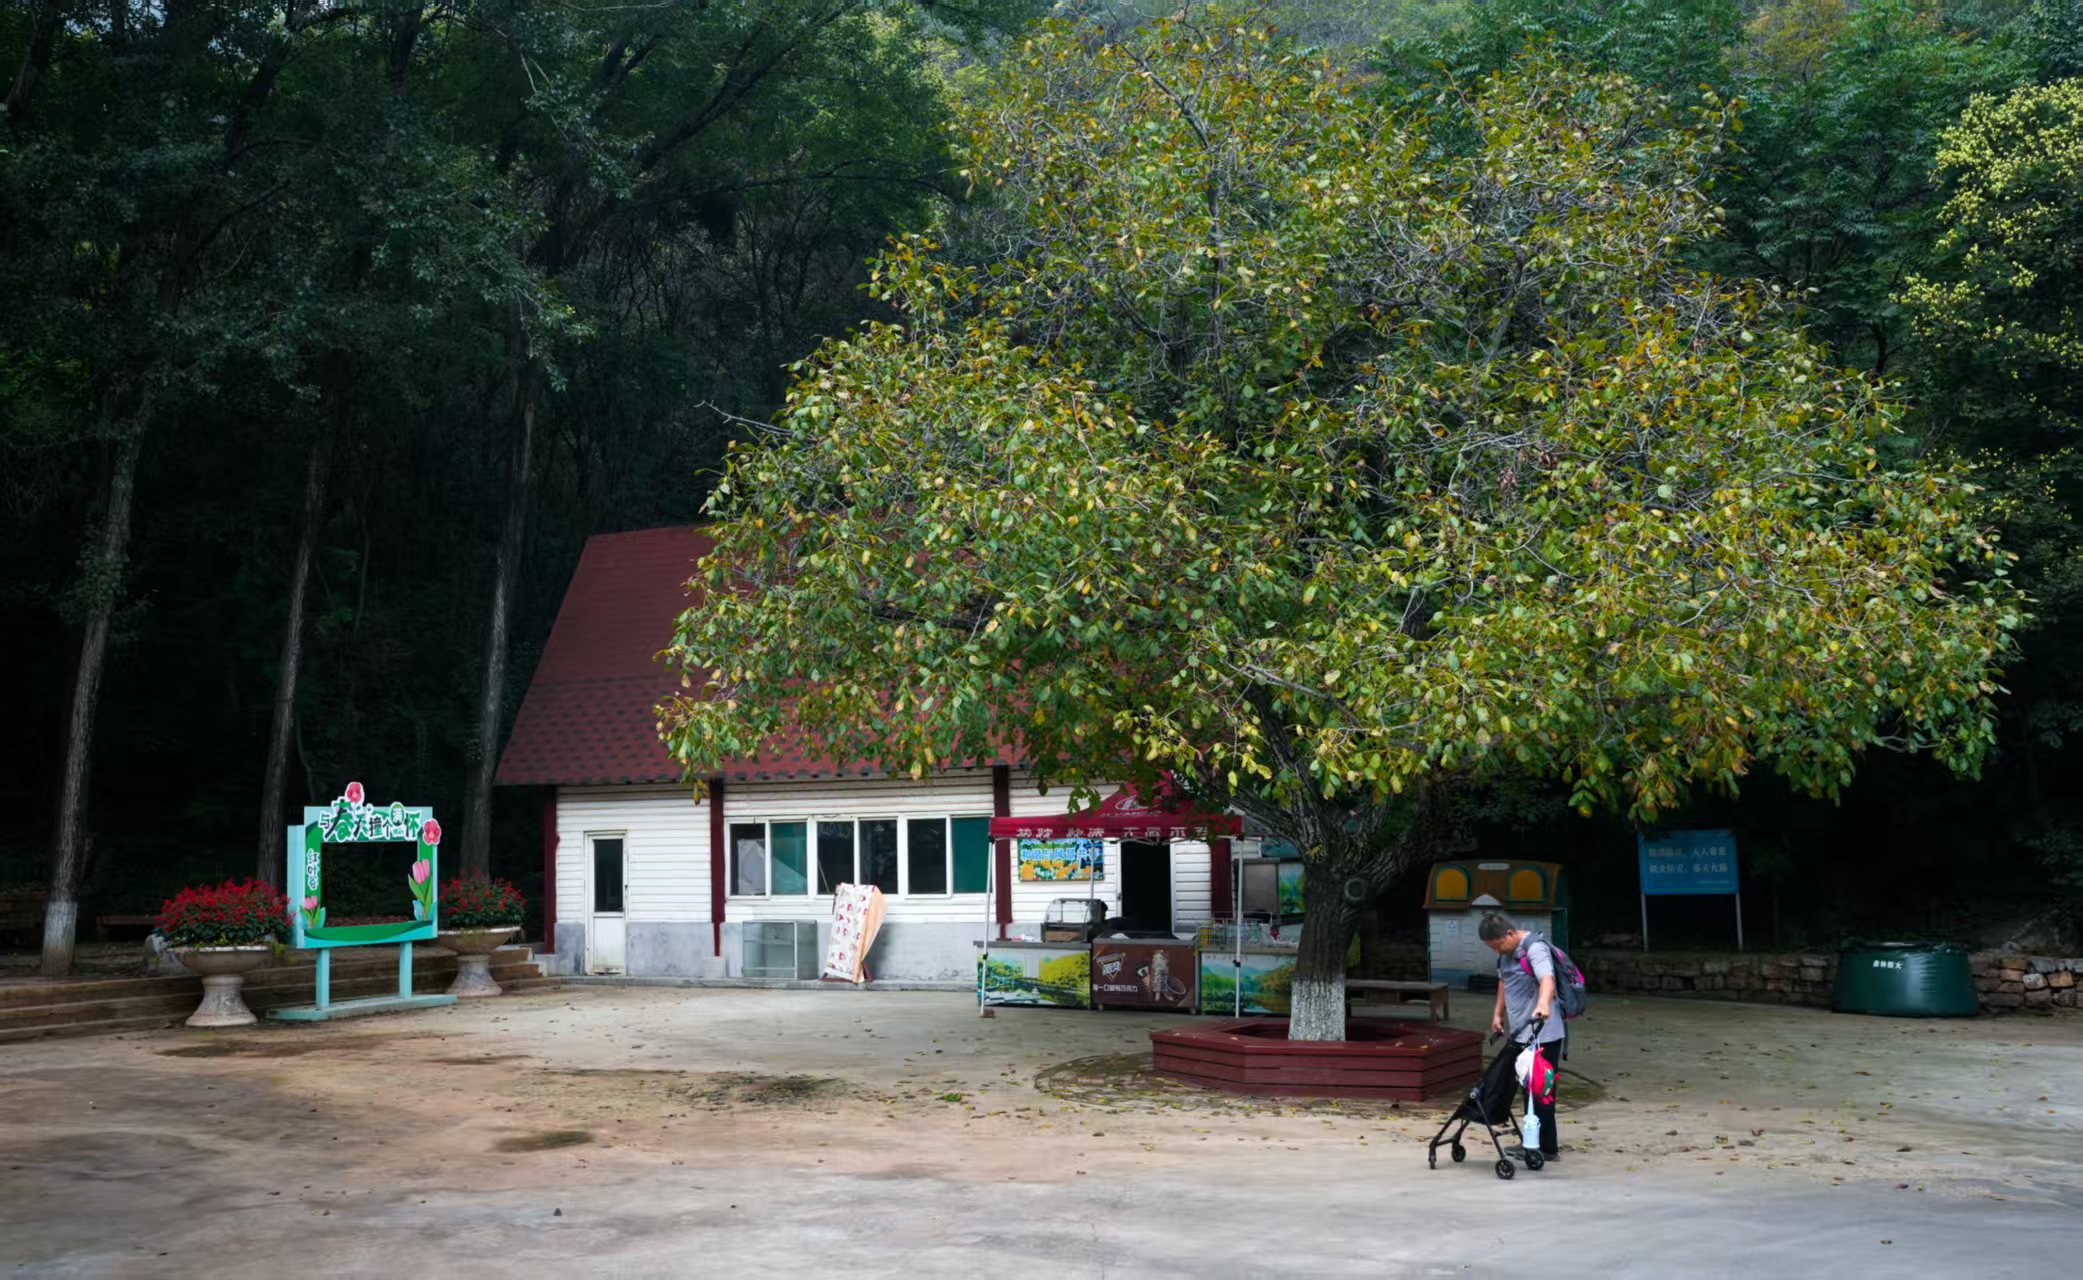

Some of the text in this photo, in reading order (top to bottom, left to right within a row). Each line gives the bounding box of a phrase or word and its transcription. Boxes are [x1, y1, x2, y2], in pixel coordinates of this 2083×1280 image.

[319, 798, 421, 841] 与春天撞个满怀
